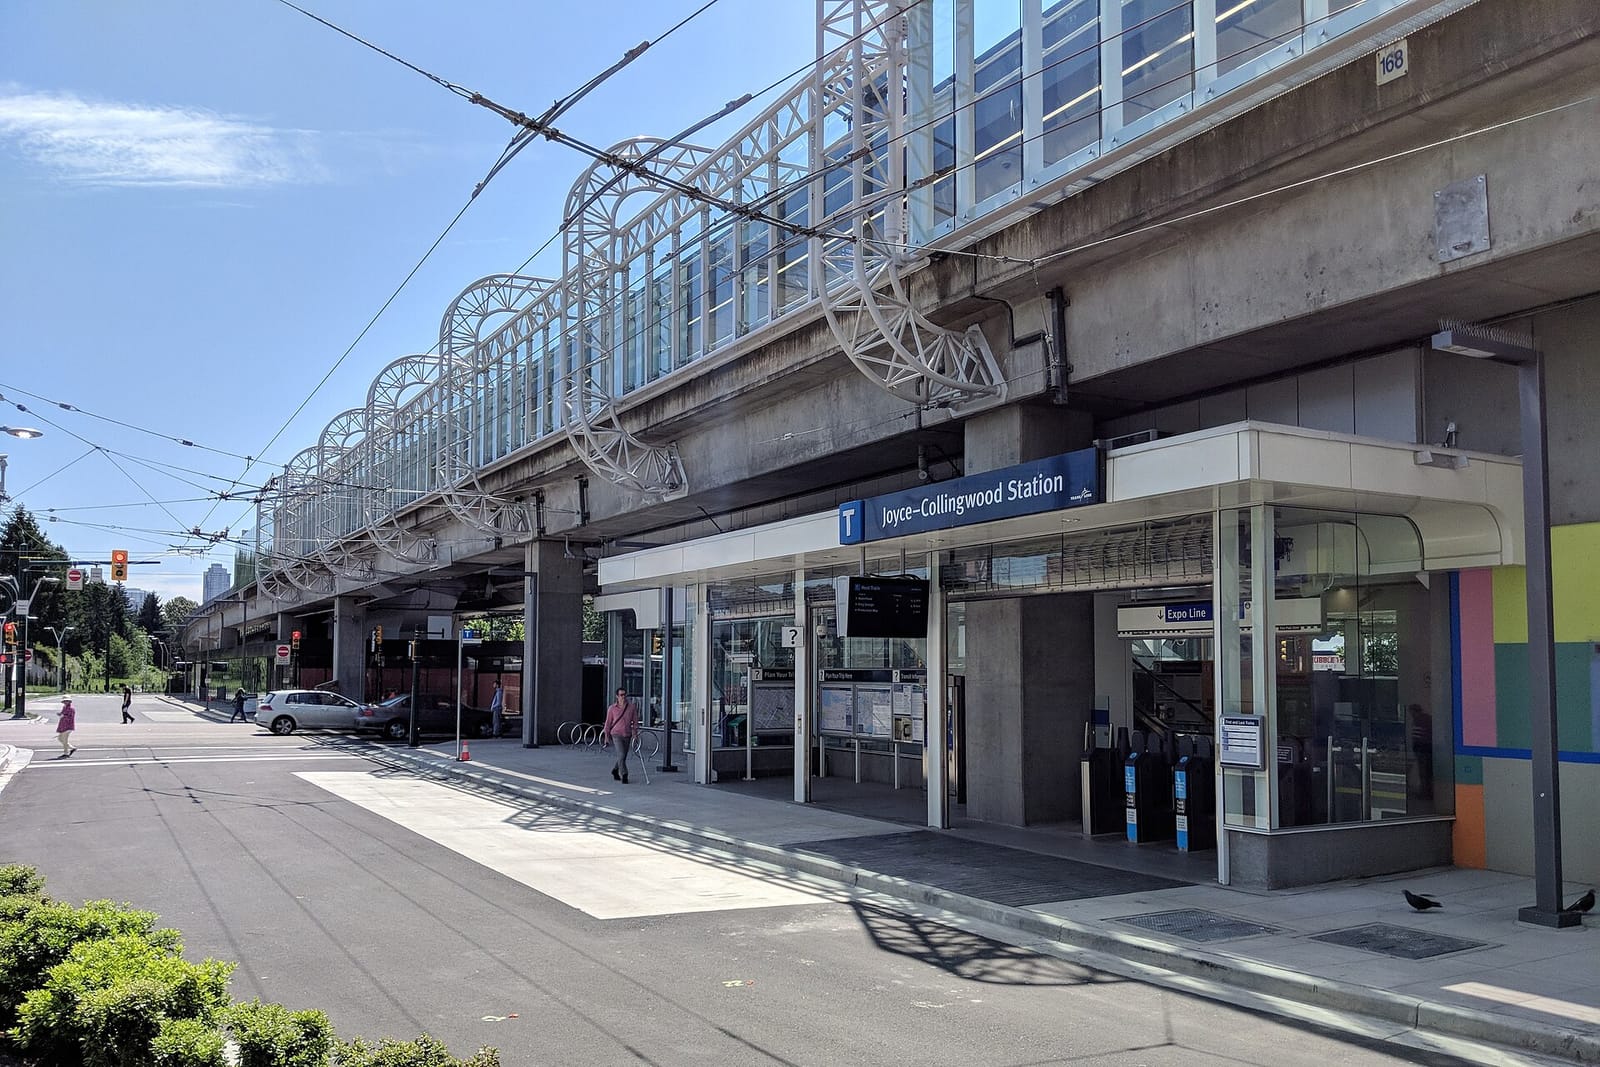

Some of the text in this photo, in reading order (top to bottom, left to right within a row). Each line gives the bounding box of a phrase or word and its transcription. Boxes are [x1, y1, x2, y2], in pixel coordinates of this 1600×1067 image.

[1380, 49, 1404, 75] 168
[1007, 473, 1063, 501] Station
[843, 508, 855, 537] T
[1167, 608, 1206, 620] Expo Line
